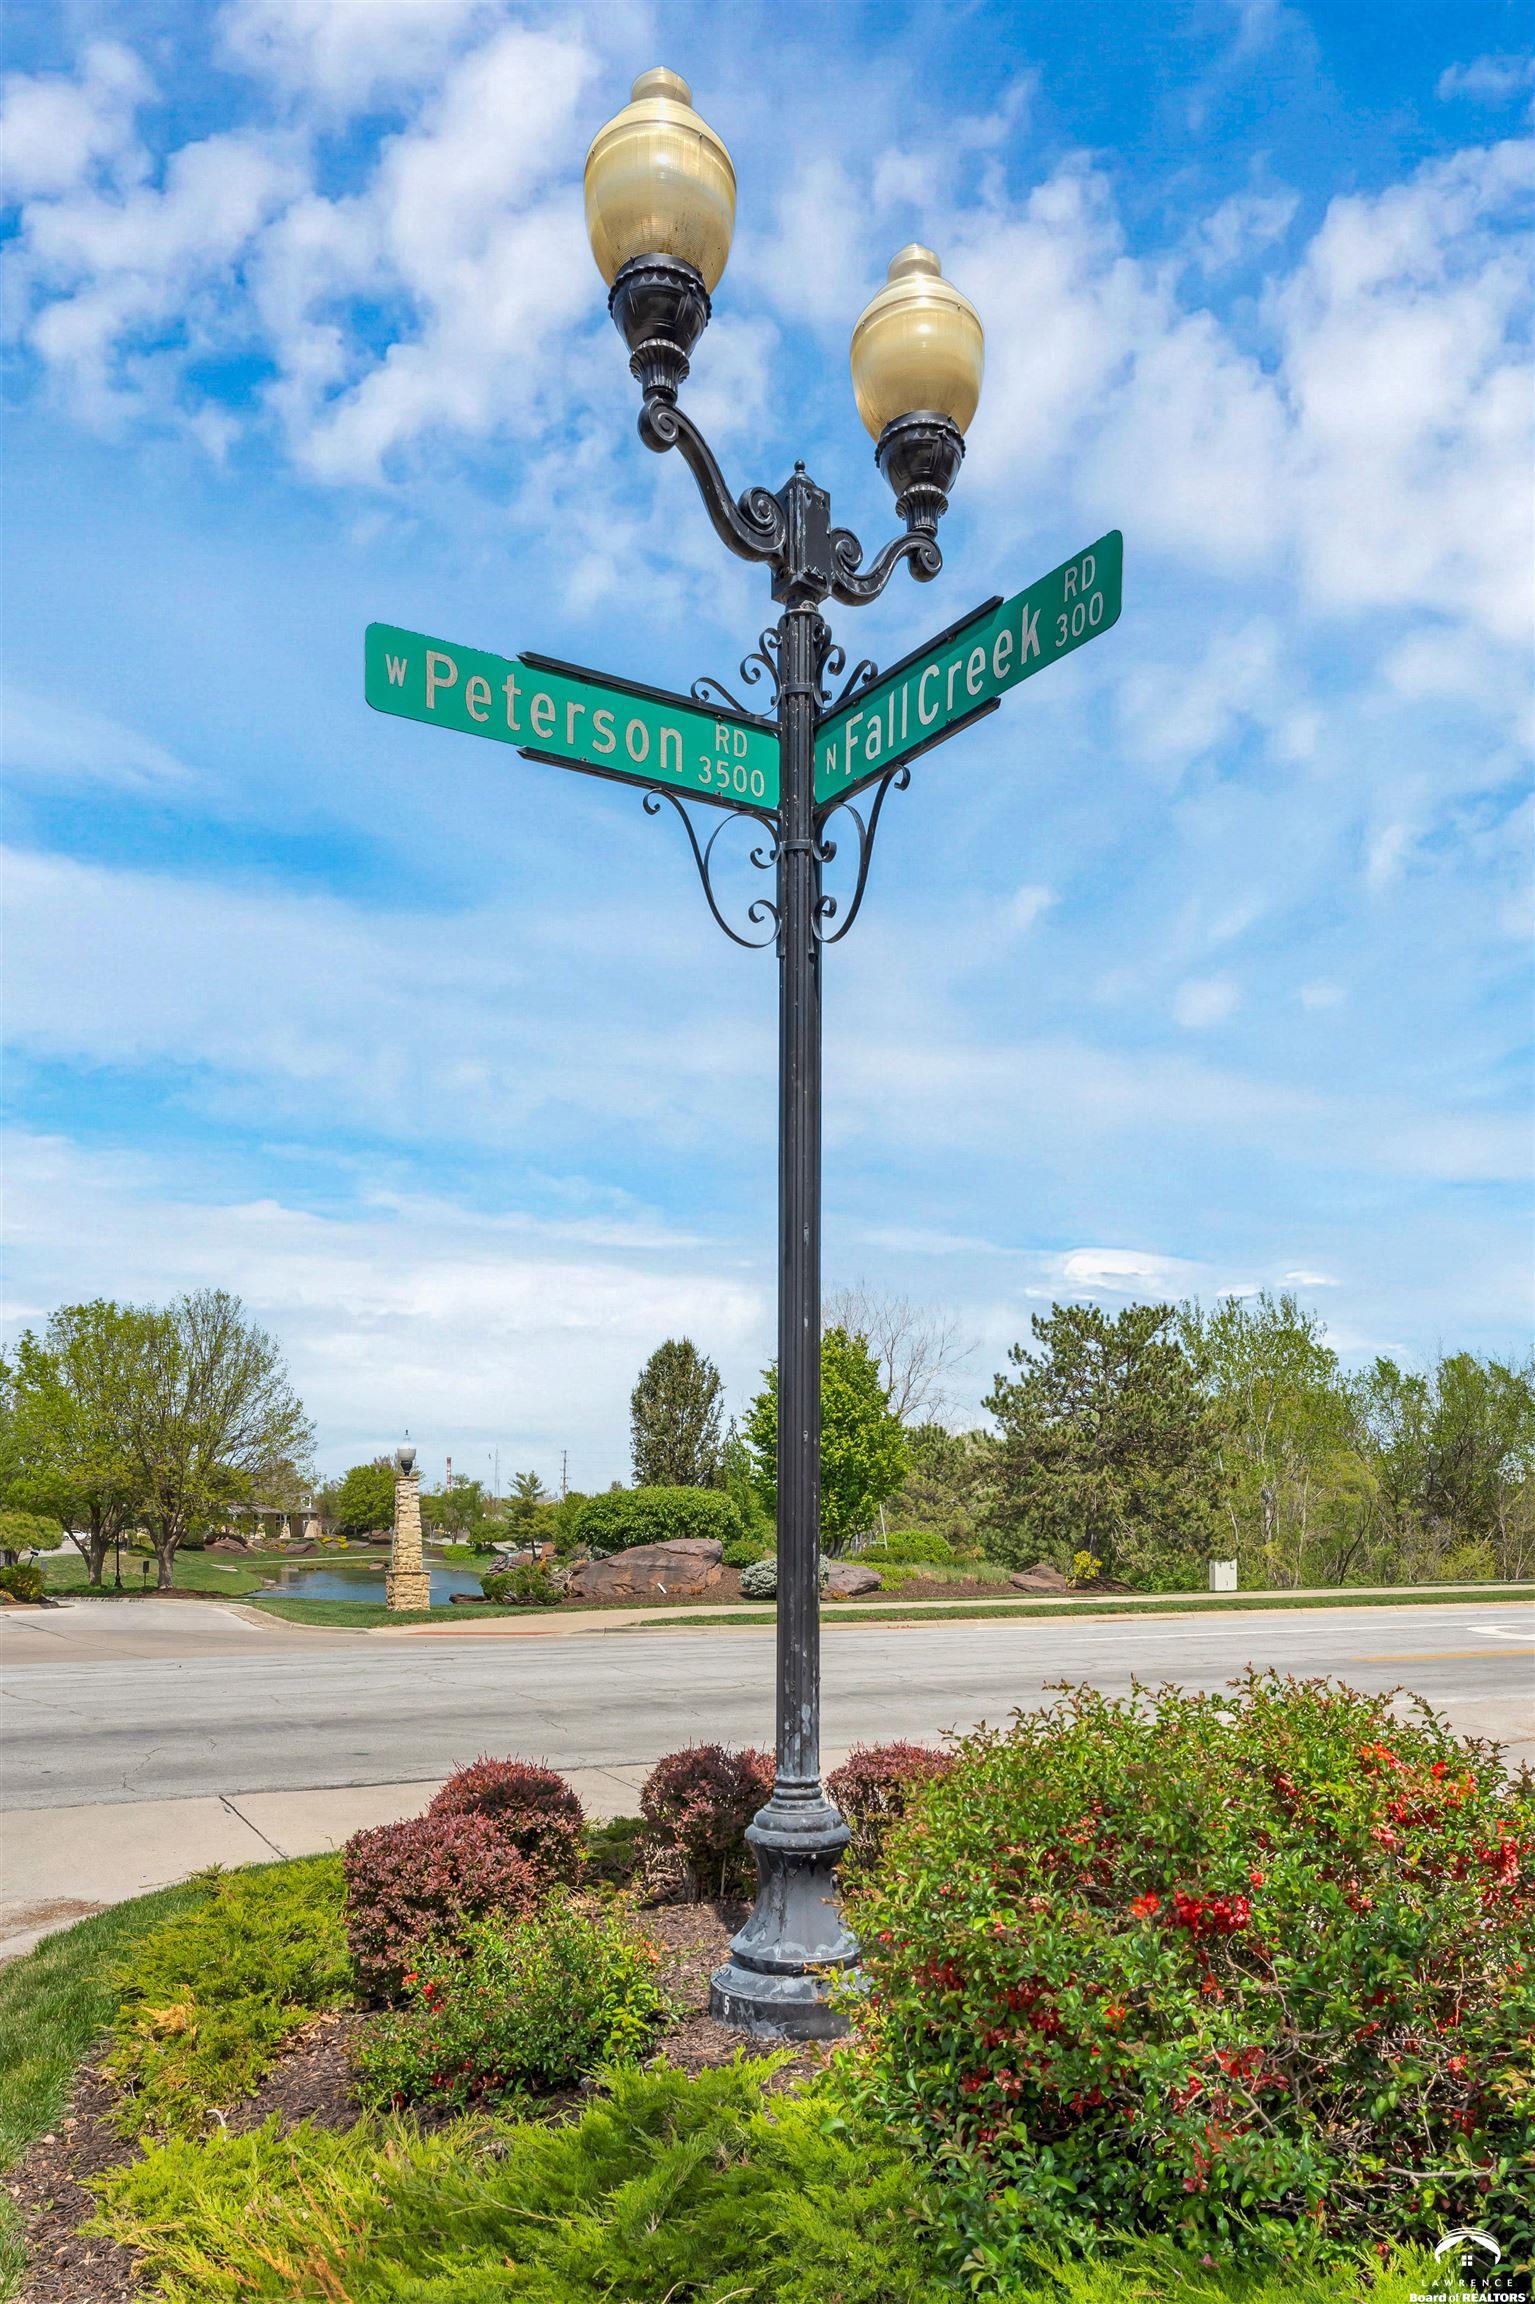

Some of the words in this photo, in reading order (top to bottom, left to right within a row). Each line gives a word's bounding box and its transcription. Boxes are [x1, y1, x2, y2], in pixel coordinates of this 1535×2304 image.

[1055, 591, 1104, 648] 300
[826, 743, 836, 775] N
[845, 602, 1041, 775] FallCreek
[1064, 555, 1096, 602] RD
[385, 653, 407, 687] W
[426, 649, 683, 772] Peterson
[715, 723, 748, 758] RD
[698, 756, 765, 797] 3500
[724, 1995, 730, 2015] 5
